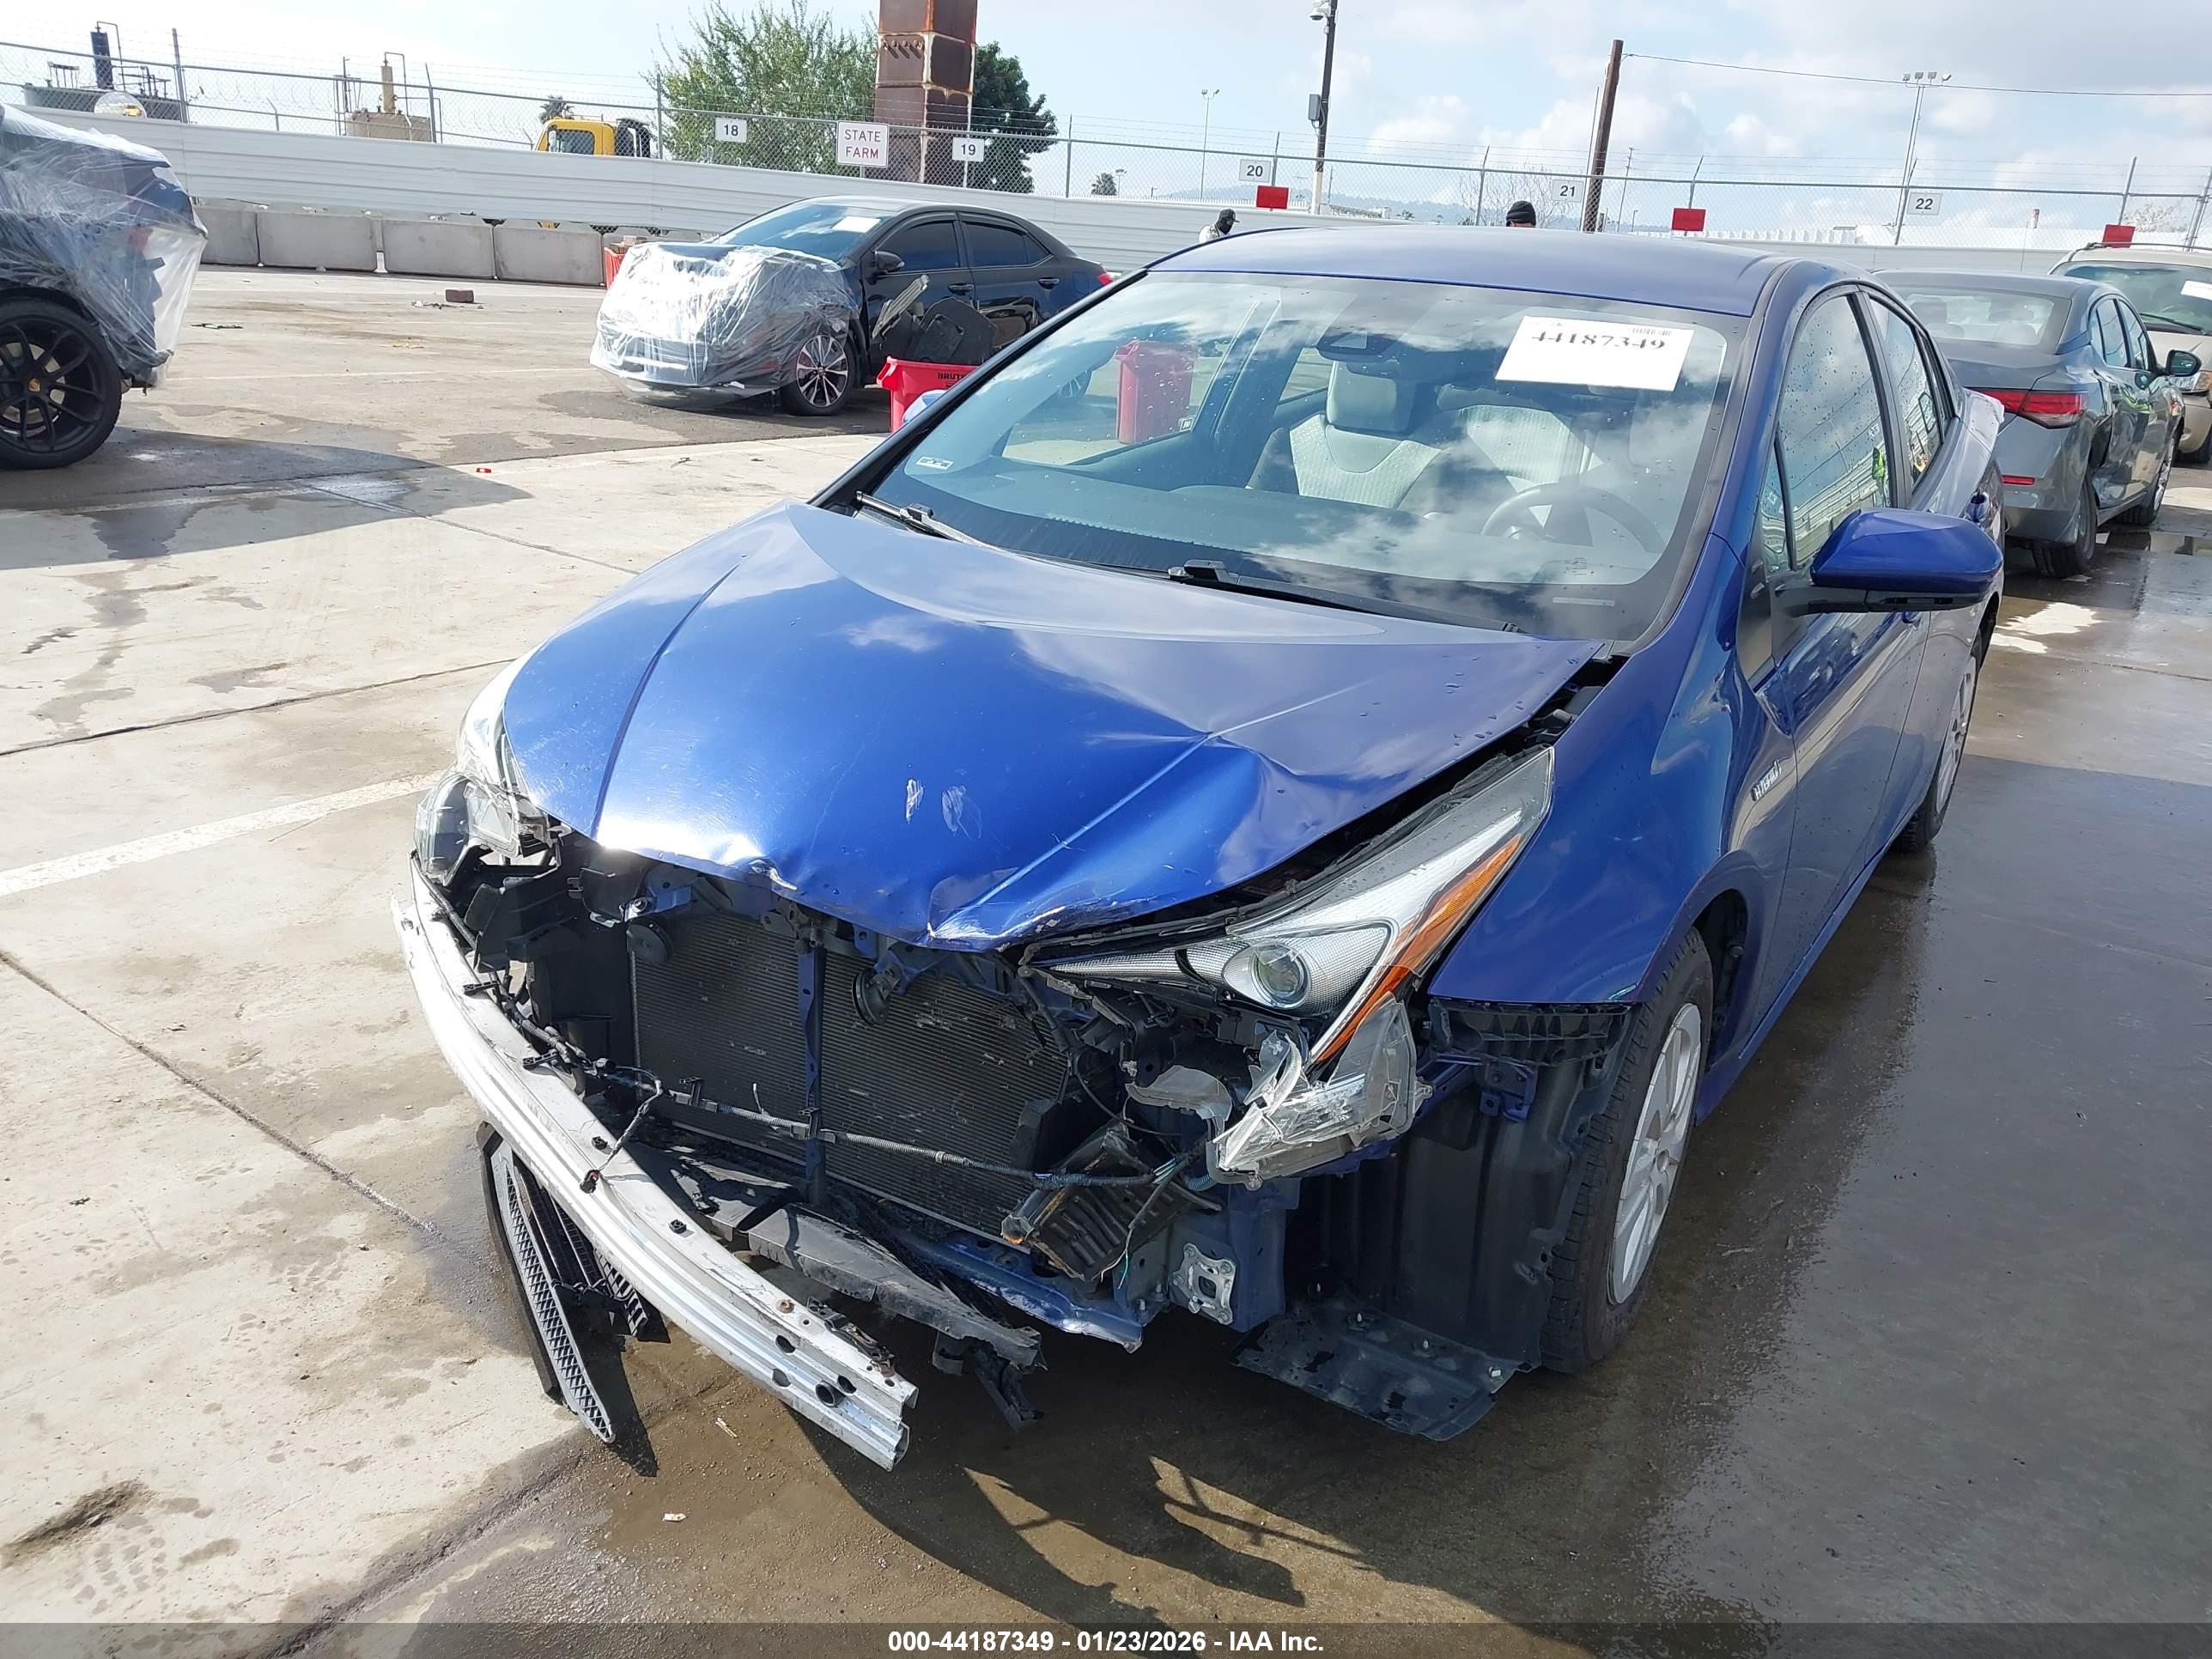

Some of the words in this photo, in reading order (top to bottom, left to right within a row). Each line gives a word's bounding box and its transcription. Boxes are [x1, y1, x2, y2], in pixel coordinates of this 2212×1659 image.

[724, 124, 738, 137] 18
[844, 129, 881, 143] STATE
[845, 145, 879, 160] FARM
[961, 143, 976, 156] 19
[1247, 165, 1263, 177] 20
[1559, 185, 1576, 197] 21
[1915, 198, 1933, 210] 22
[1531, 331, 1666, 349] 44187349
